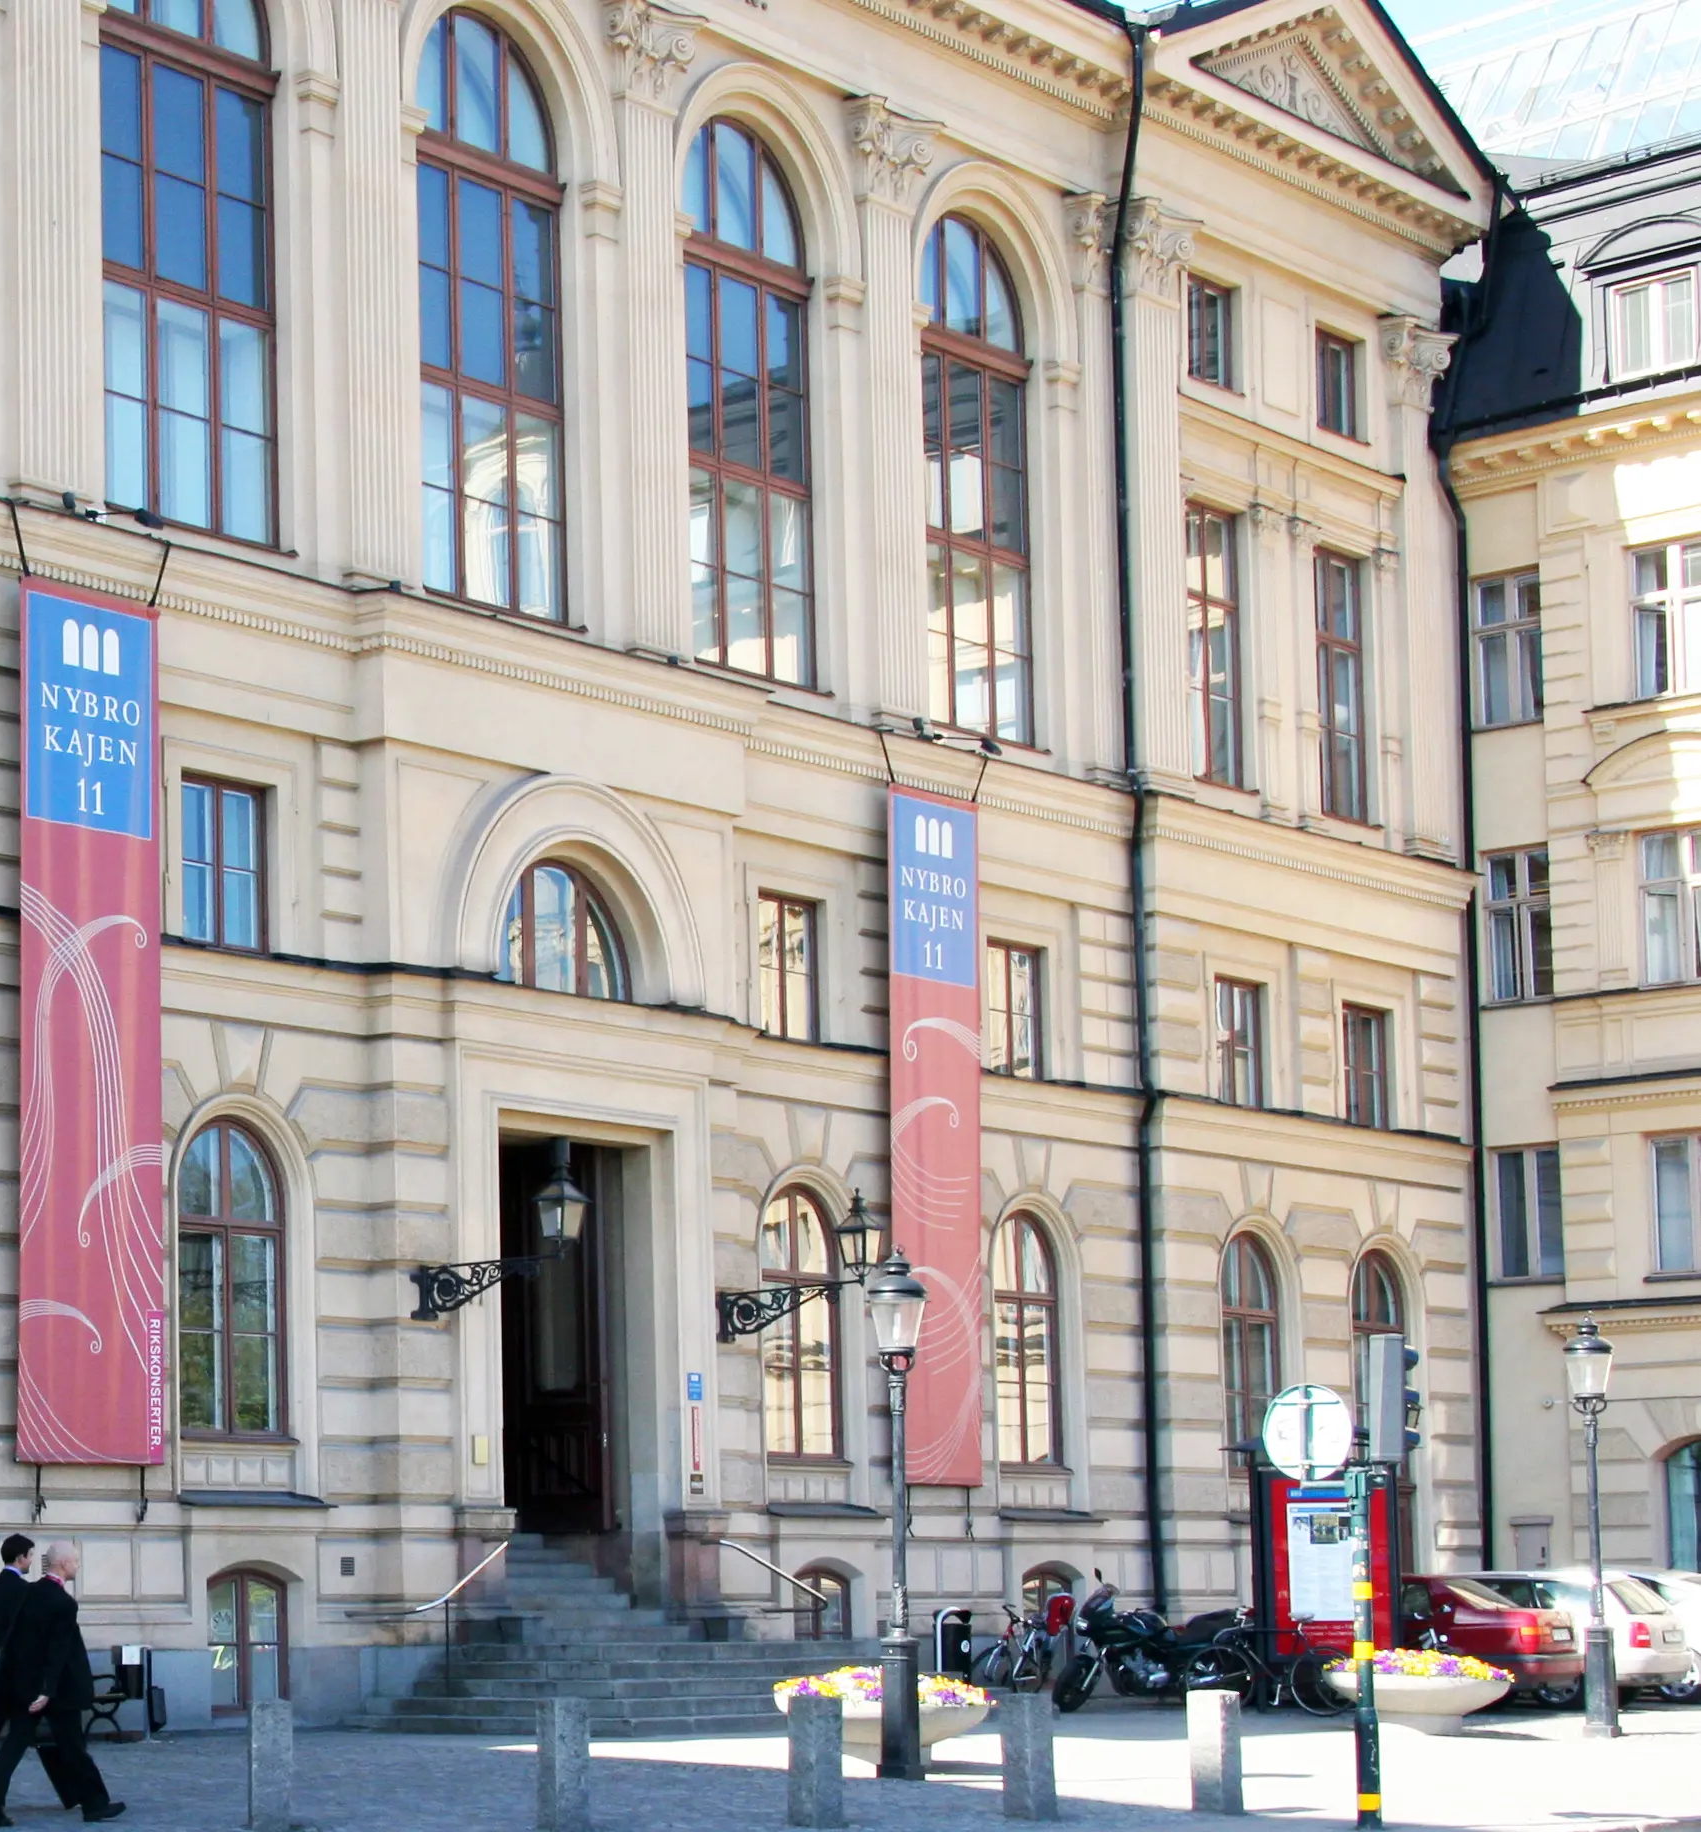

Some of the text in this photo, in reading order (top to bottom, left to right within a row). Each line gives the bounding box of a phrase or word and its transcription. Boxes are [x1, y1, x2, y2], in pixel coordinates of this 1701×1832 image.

[40, 681, 141, 727] NYBRO
[43, 724, 139, 768] KAJEN
[76, 778, 105, 816] 11
[900, 865, 967, 899] NYBRO
[903, 899, 964, 933] KAJEN
[923, 940, 944, 970] 11
[149, 1318, 162, 1451] RIKSKONSERTER.
